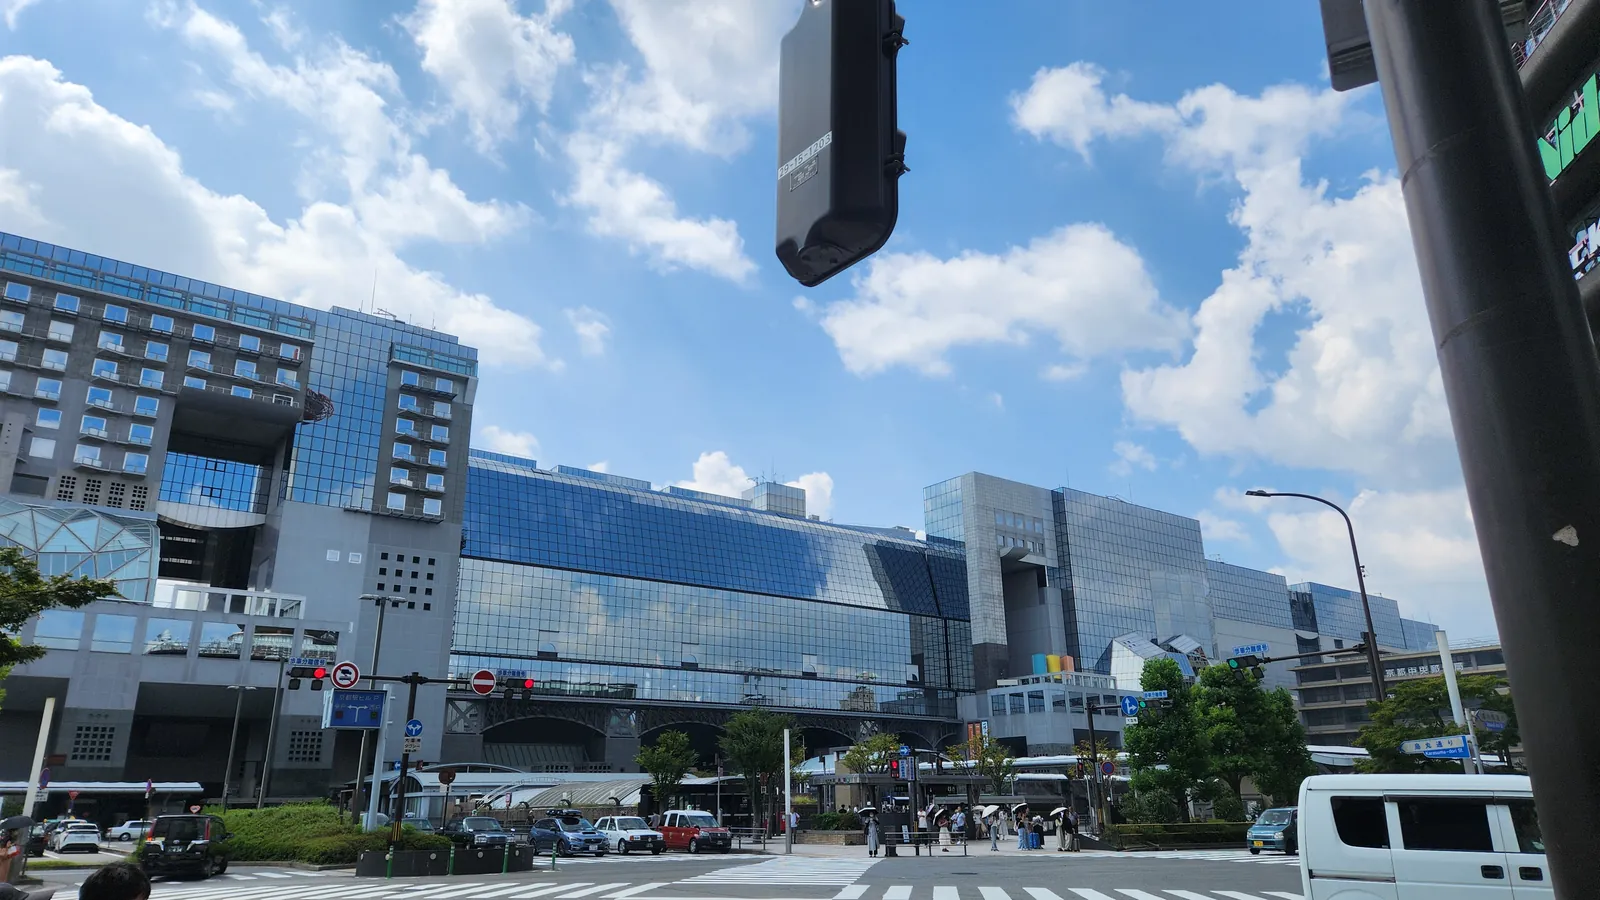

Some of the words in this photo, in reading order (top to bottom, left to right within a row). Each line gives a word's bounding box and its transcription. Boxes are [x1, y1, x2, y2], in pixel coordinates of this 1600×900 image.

[779, 133, 831, 178] 29-15-1203
[1385, 661, 1464, 678] 京都中央郵局
